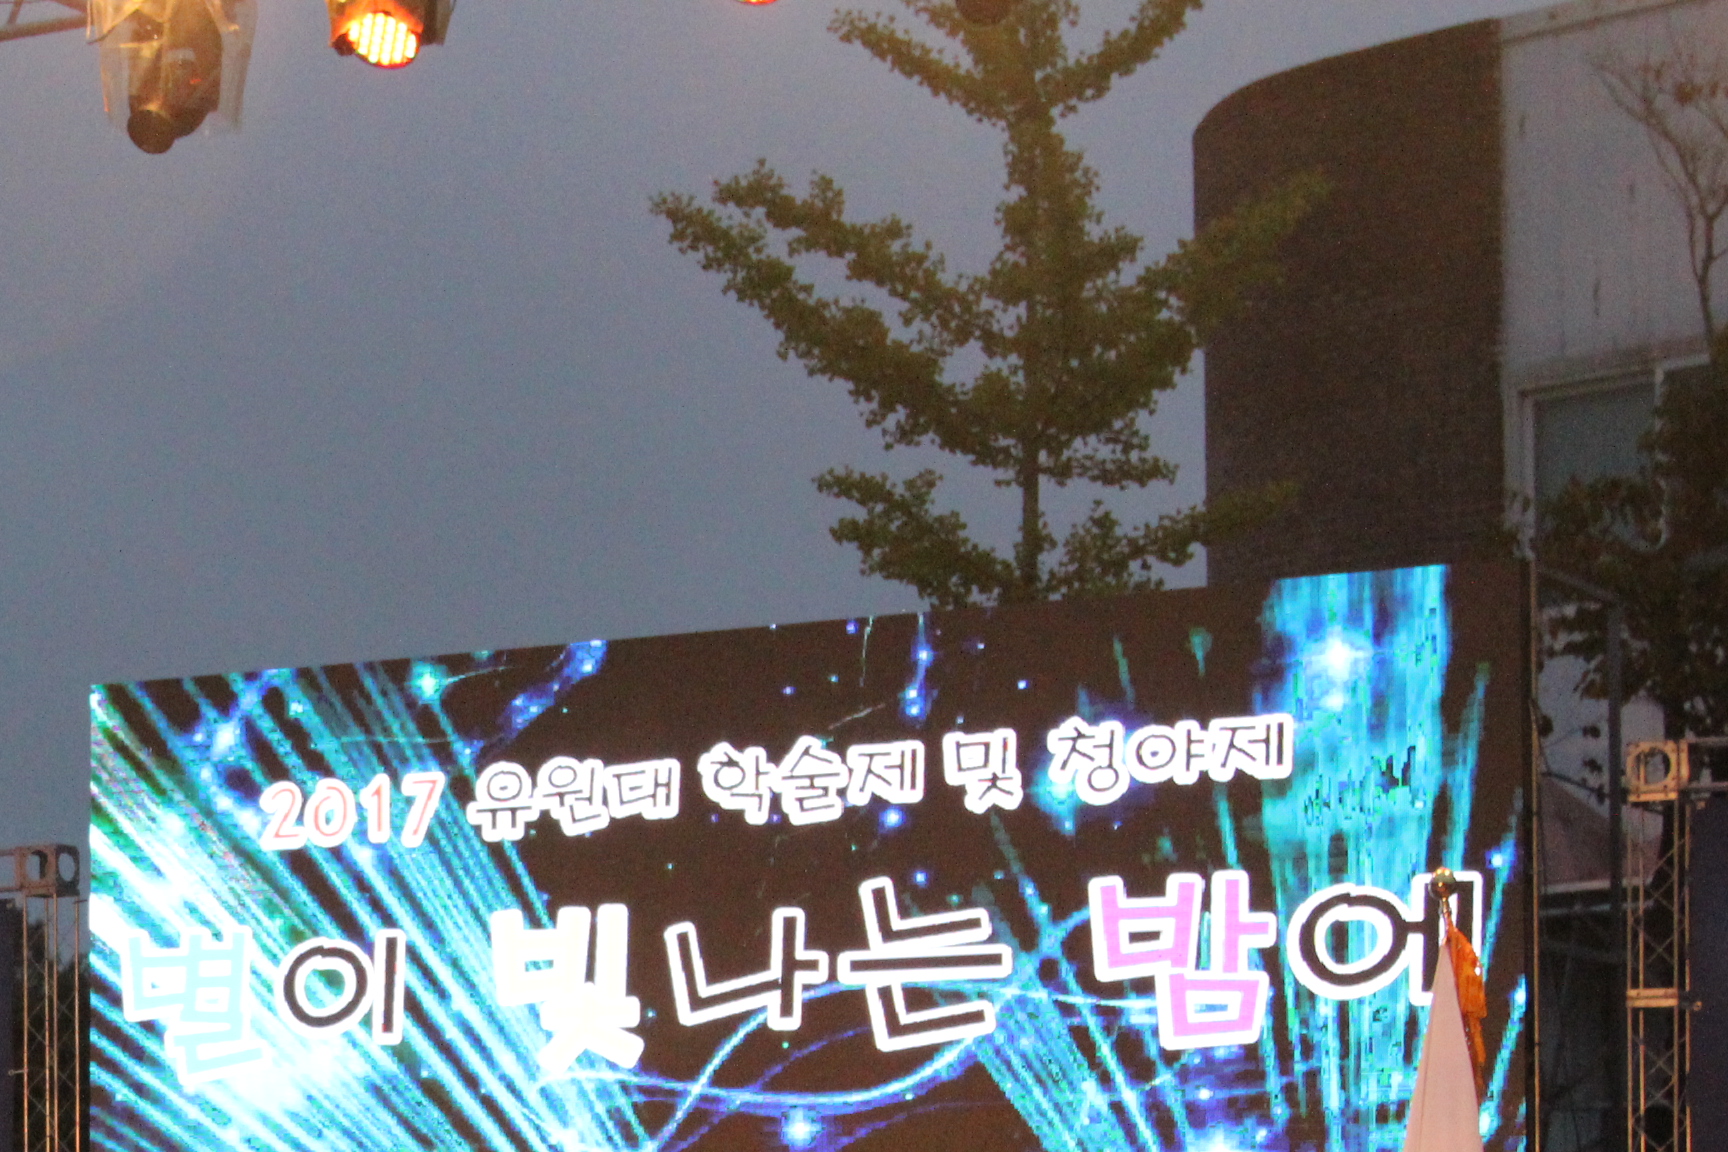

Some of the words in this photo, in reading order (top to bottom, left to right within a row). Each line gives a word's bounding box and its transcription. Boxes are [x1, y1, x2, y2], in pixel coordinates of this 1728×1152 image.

[259, 771, 446, 850] 2017
[466, 755, 681, 842] 유원대
[698, 734, 925, 826] 학술제
[943, 728, 1024, 814] 및
[1047, 713, 1294, 806] 청야제
[122, 925, 407, 1086] 별이
[490, 876, 1014, 1074] 빛나는
